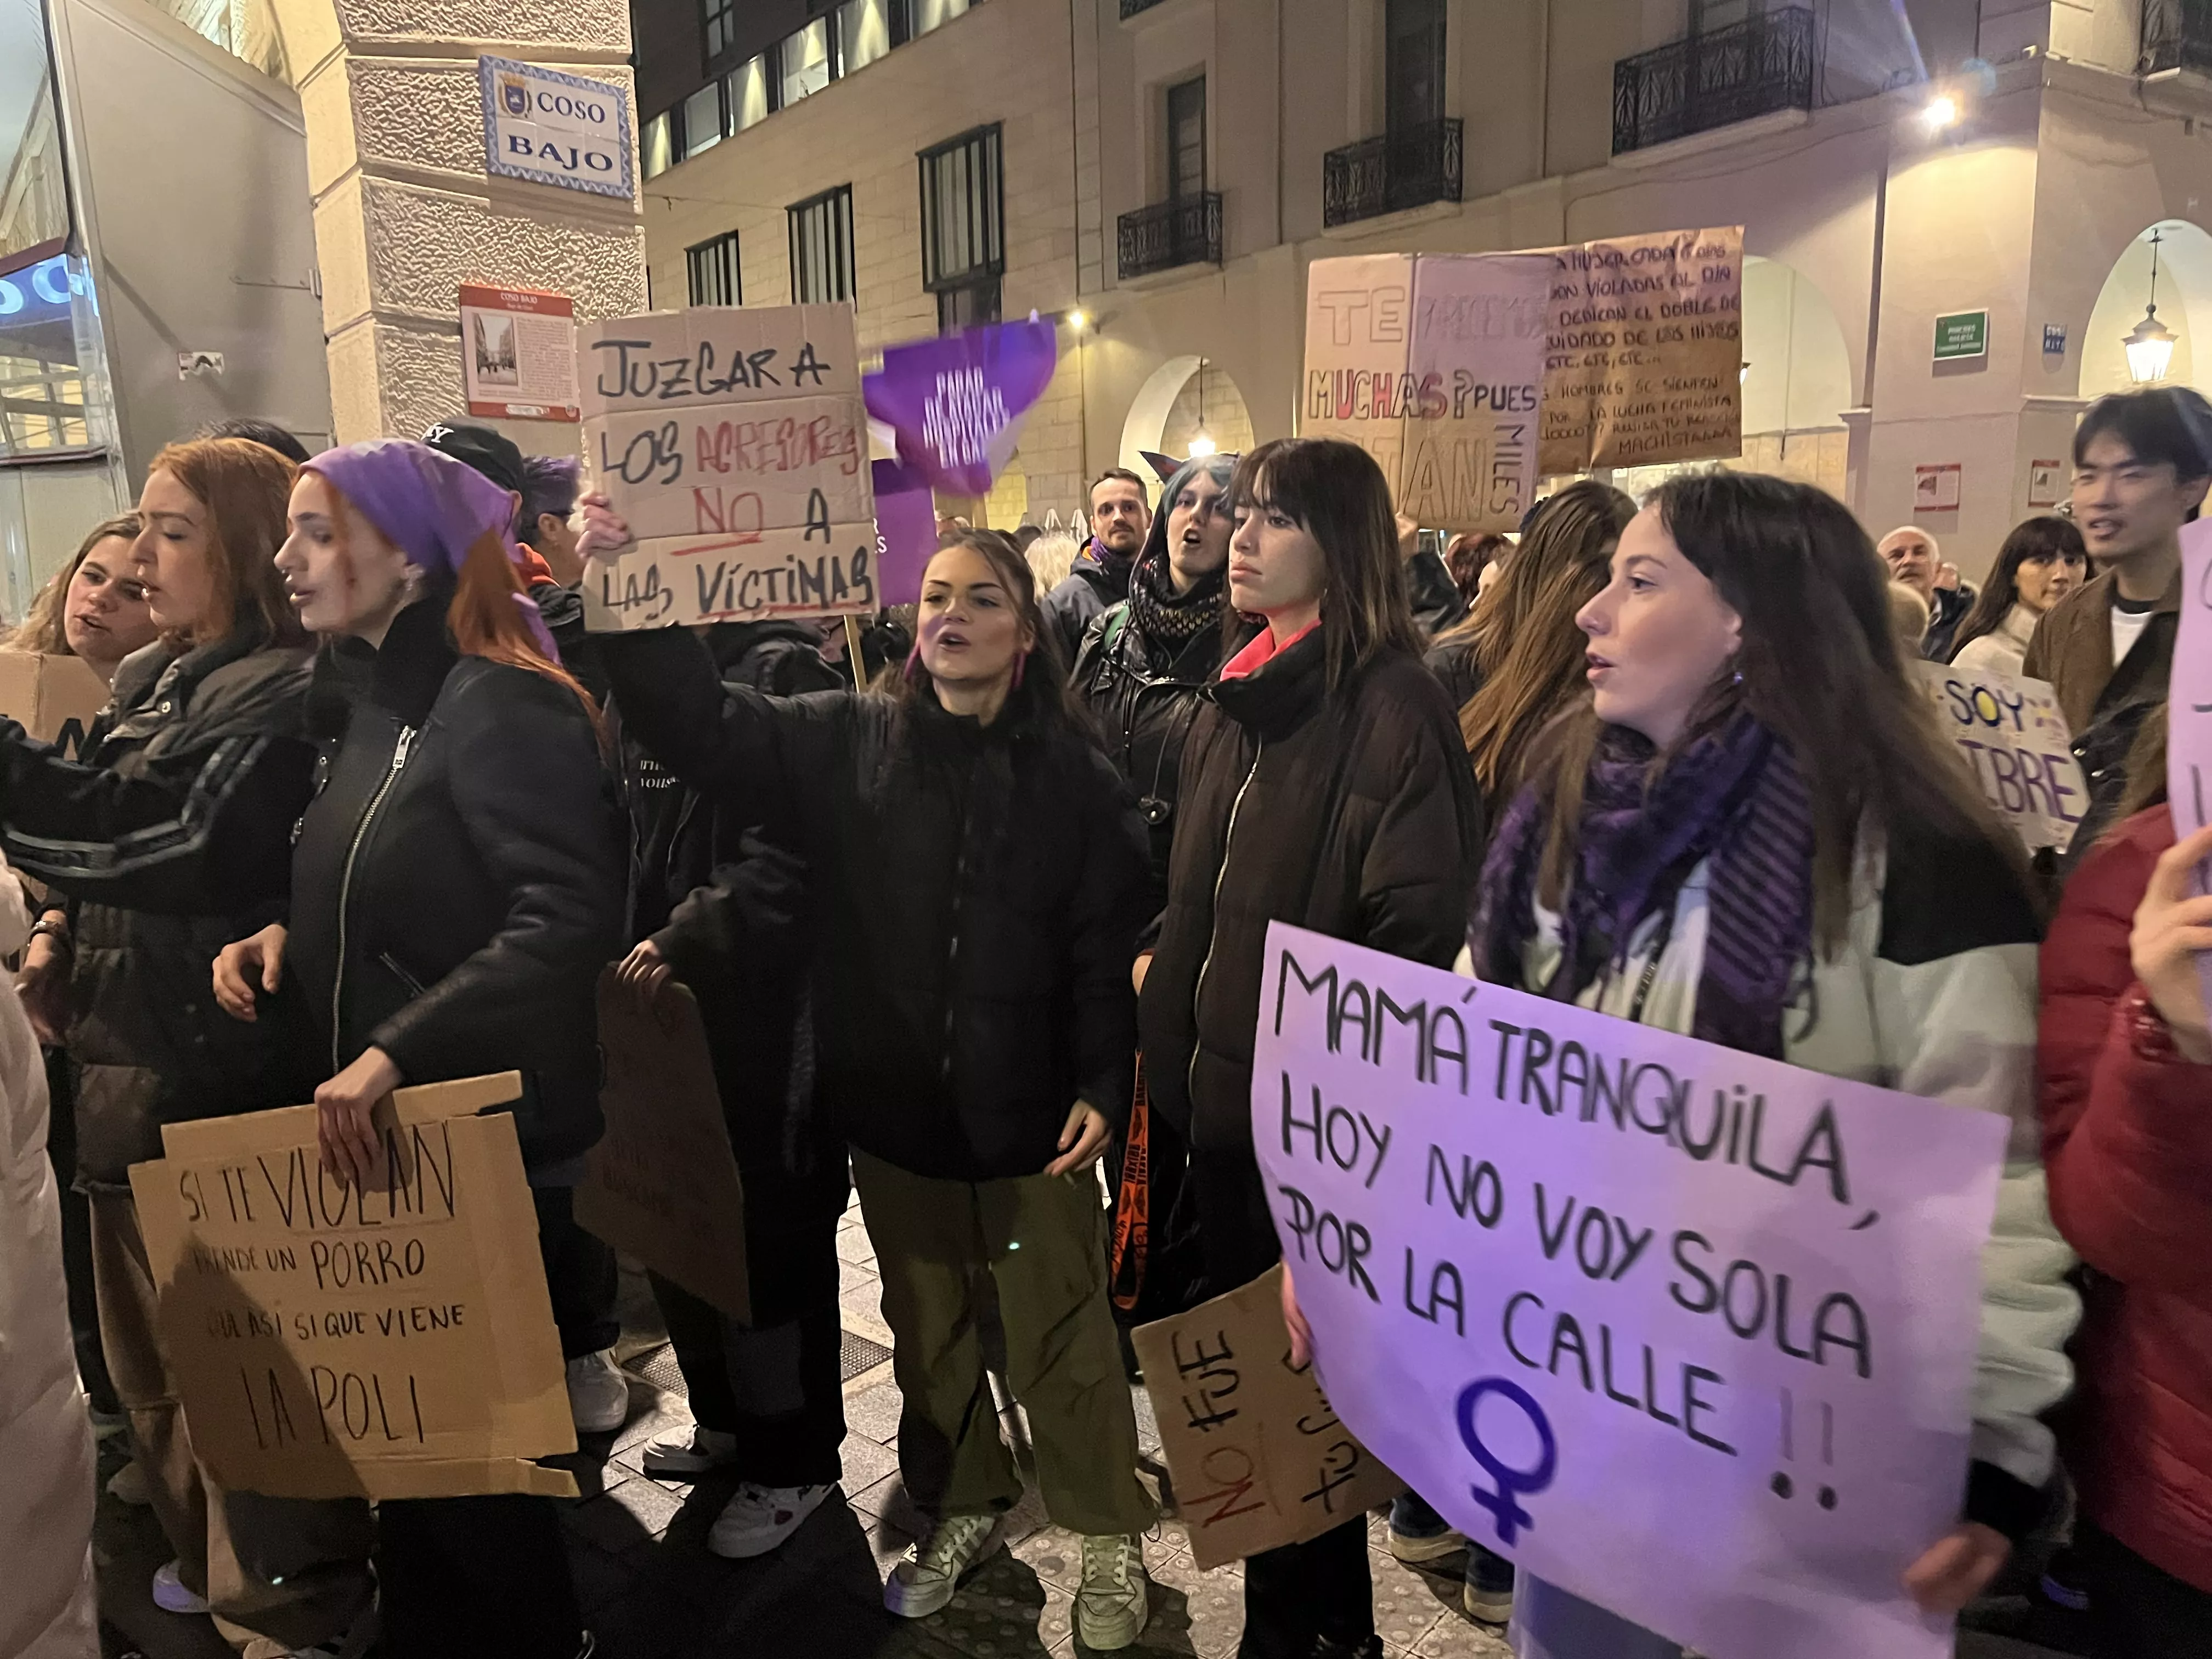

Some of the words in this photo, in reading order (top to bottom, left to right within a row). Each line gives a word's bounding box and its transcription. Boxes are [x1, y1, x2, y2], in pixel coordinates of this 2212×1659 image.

[537, 92, 605, 123] COSO
[507, 134, 613, 172] BAJO
[1317, 285, 1406, 346] TE
[1559, 305, 1627, 326] DEDICAN
[1586, 275, 1664, 298] VIOLADAS
[591, 340, 781, 399] JUZGAR
[789, 341, 831, 387] A
[1474, 384, 1537, 413] PUES
[601, 421, 683, 484] LOS
[695, 415, 860, 476] AGRESORES
[1489, 424, 1527, 515] MILES
[692, 487, 764, 538] NO
[804, 487, 831, 545] A
[603, 563, 673, 620] LAS
[1945, 679, 2025, 732] SOY
[1274, 949, 1477, 1096] MAMÁ
[179, 1170, 210, 1223] SI
[221, 1165, 258, 1223] TE
[1280, 1069, 1392, 1189] HOY
[1426, 1143, 1504, 1231] NO
[1533, 1181, 1655, 1282] VOY
[1667, 1229, 1873, 1379] SOLA
[265, 1245, 297, 1272] UN
[310, 1238, 425, 1290] PORRO
[324, 1311, 366, 1339] QUE
[375, 1302, 467, 1338] VIENE
[1278, 1184, 1383, 1306] POR
[1404, 1244, 1467, 1339] LA
[1502, 1290, 1740, 1458] CALLE
[240, 1362, 298, 1450] LA
[309, 1364, 426, 1446] POLI
[1172, 1330, 1239, 1433] FUE
[1182, 1445, 1265, 1528] NO
